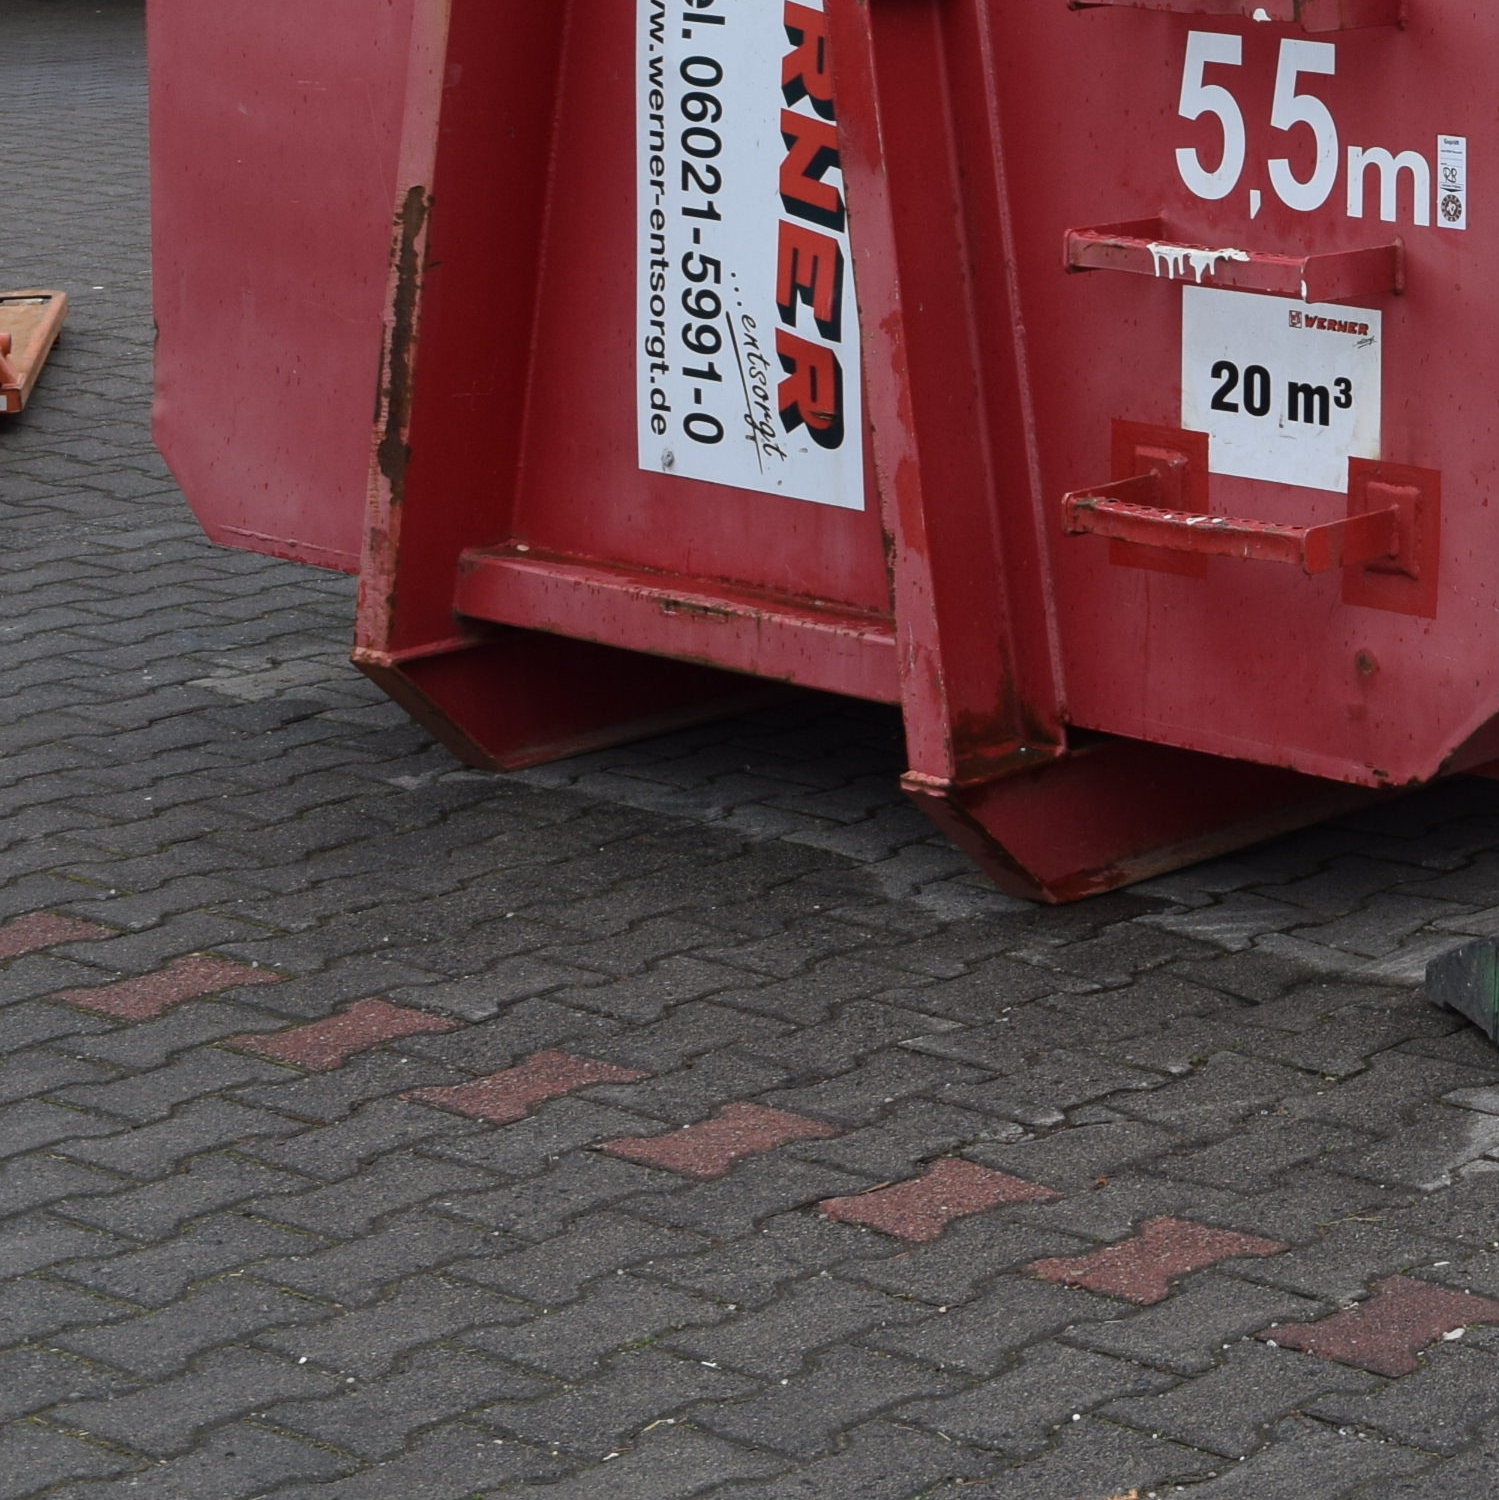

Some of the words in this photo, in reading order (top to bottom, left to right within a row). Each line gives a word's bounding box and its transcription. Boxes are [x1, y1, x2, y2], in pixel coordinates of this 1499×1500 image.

[1175, 31, 1430, 227] 5,5m
[680, 56, 724, 445] 06021-5991-0
[1304, 313, 1370, 336] WERNER
[1210, 360, 1272, 418] 20
